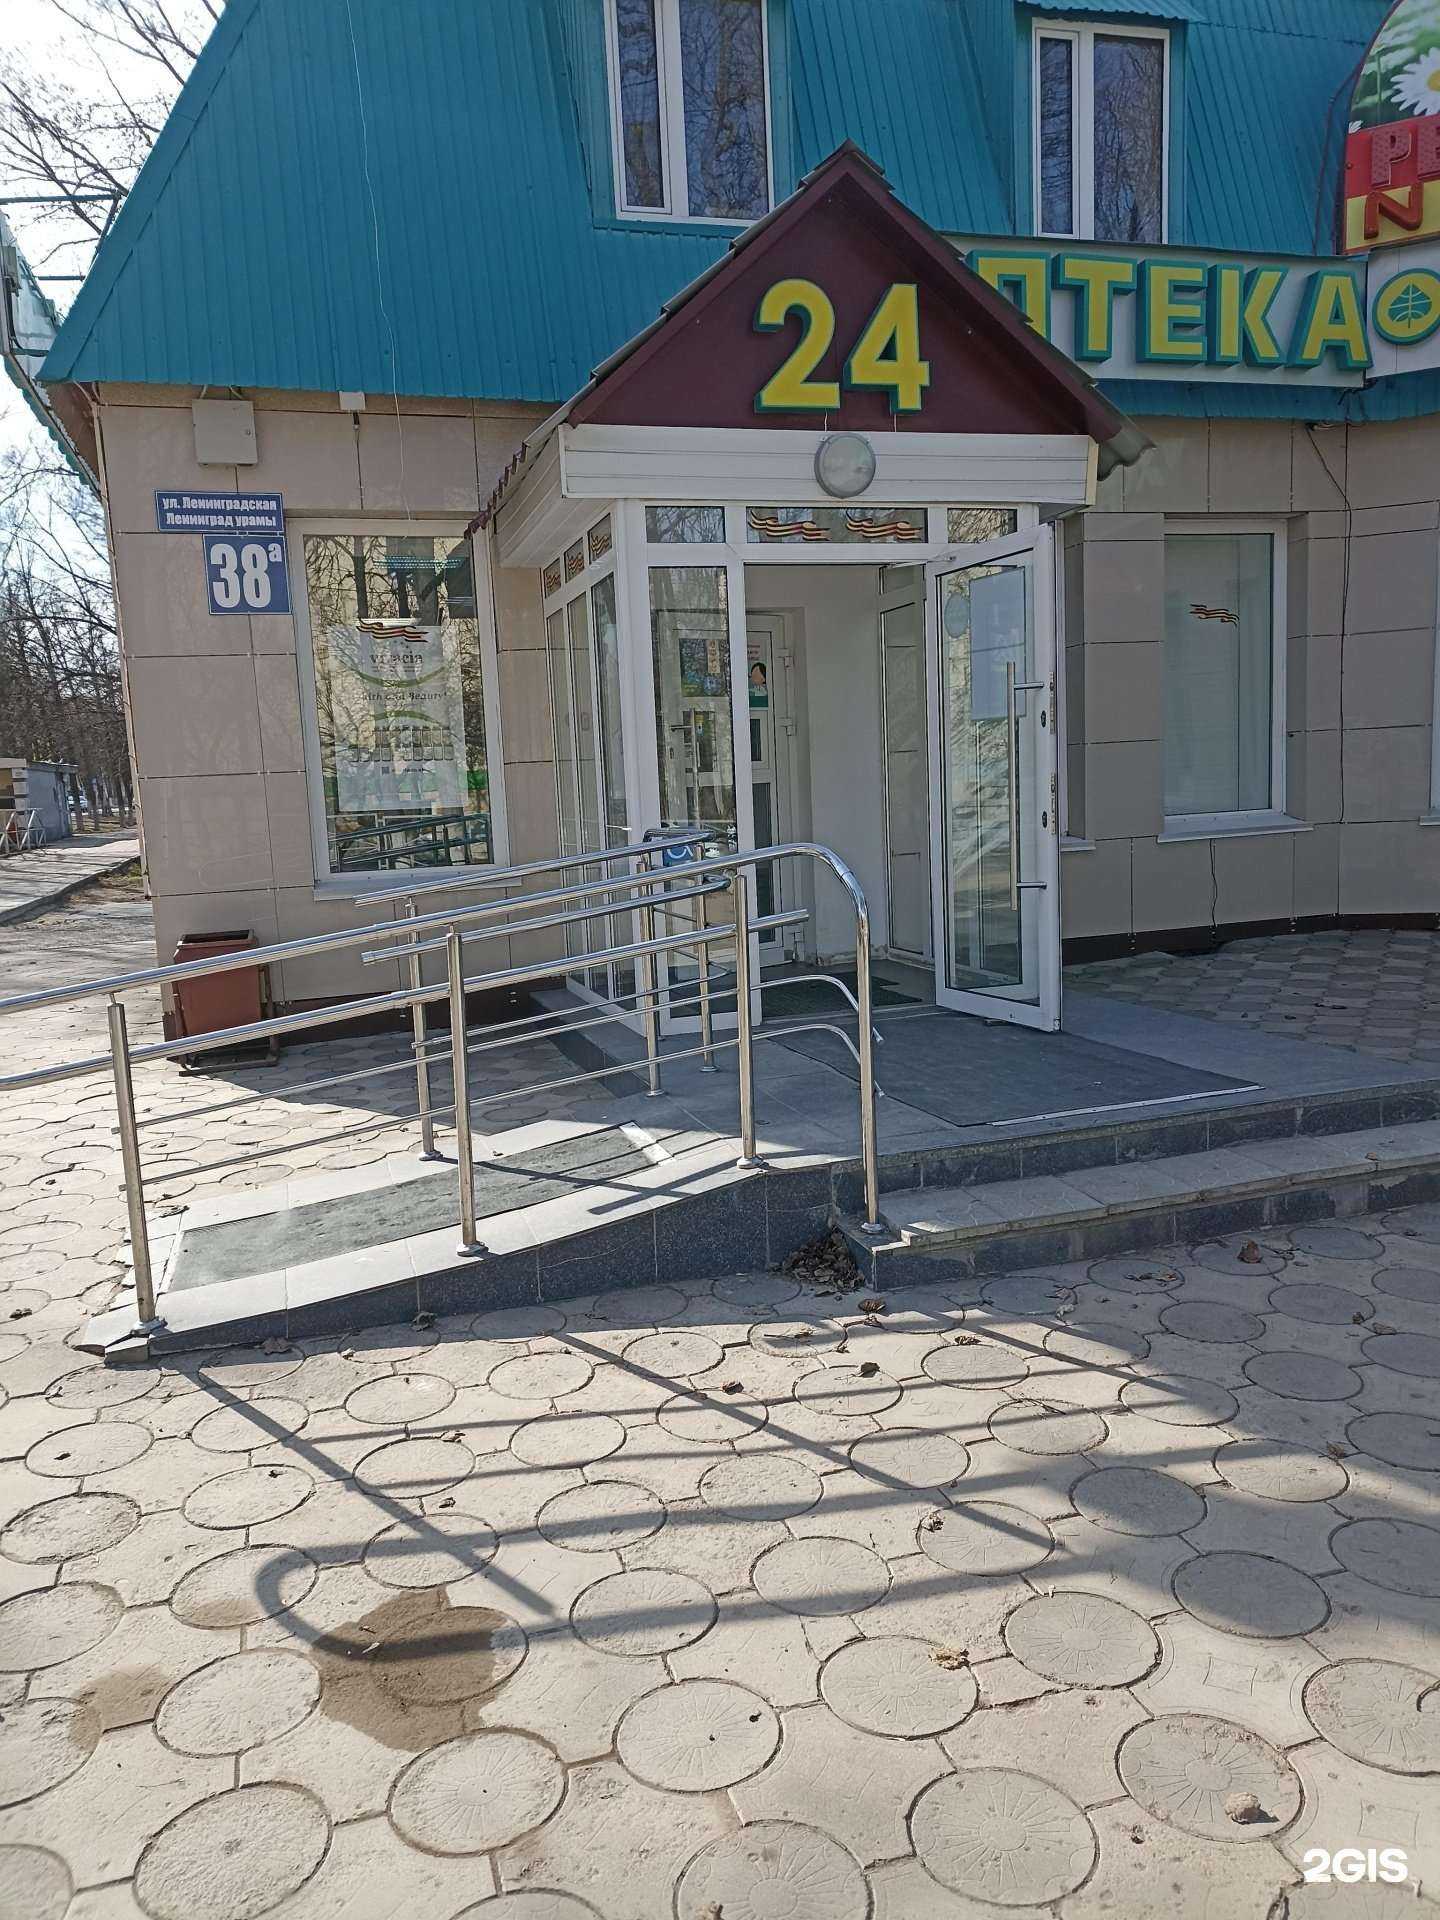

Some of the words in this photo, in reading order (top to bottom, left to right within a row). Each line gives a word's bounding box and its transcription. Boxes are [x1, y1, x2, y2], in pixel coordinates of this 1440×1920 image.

[970, 250, 1373, 368] ПТЕКА
[753, 278, 931, 415] 24
[162, 497, 181, 509] ул.
[182, 497, 277, 511] Ленинградская
[166, 512, 233, 526] Ленинград
[234, 514, 277, 527] урамы
